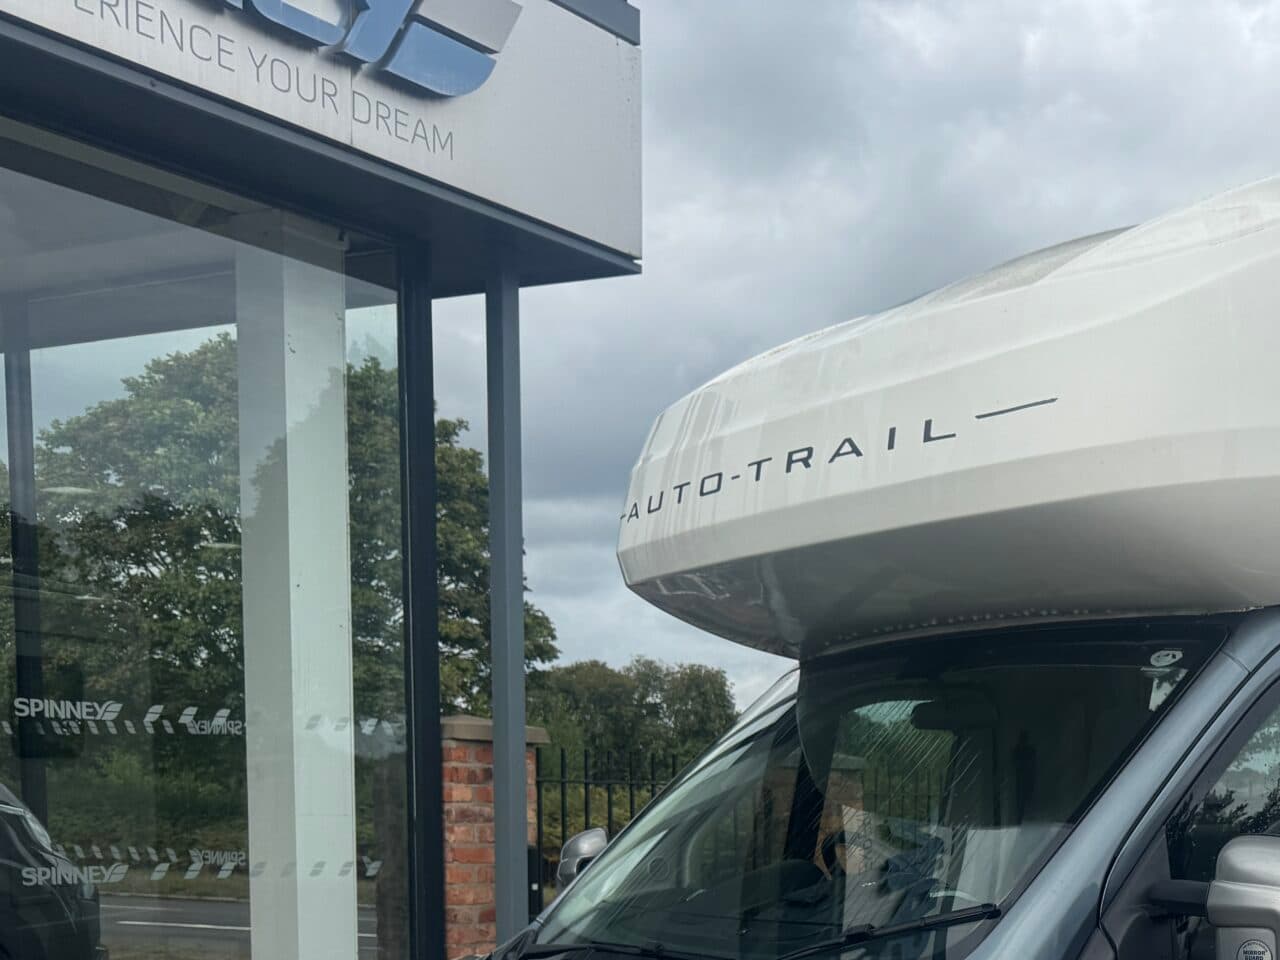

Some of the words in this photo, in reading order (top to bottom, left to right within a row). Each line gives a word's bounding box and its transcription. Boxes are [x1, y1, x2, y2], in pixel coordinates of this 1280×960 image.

[247, 46, 339, 115] YOUR
[352, 90, 454, 161] DREAM
[626, 418, 957, 524] AUTO-TRAIL
[13, 697, 116, 721] SPINNEY
[21, 862, 122, 887] SPINNEY
